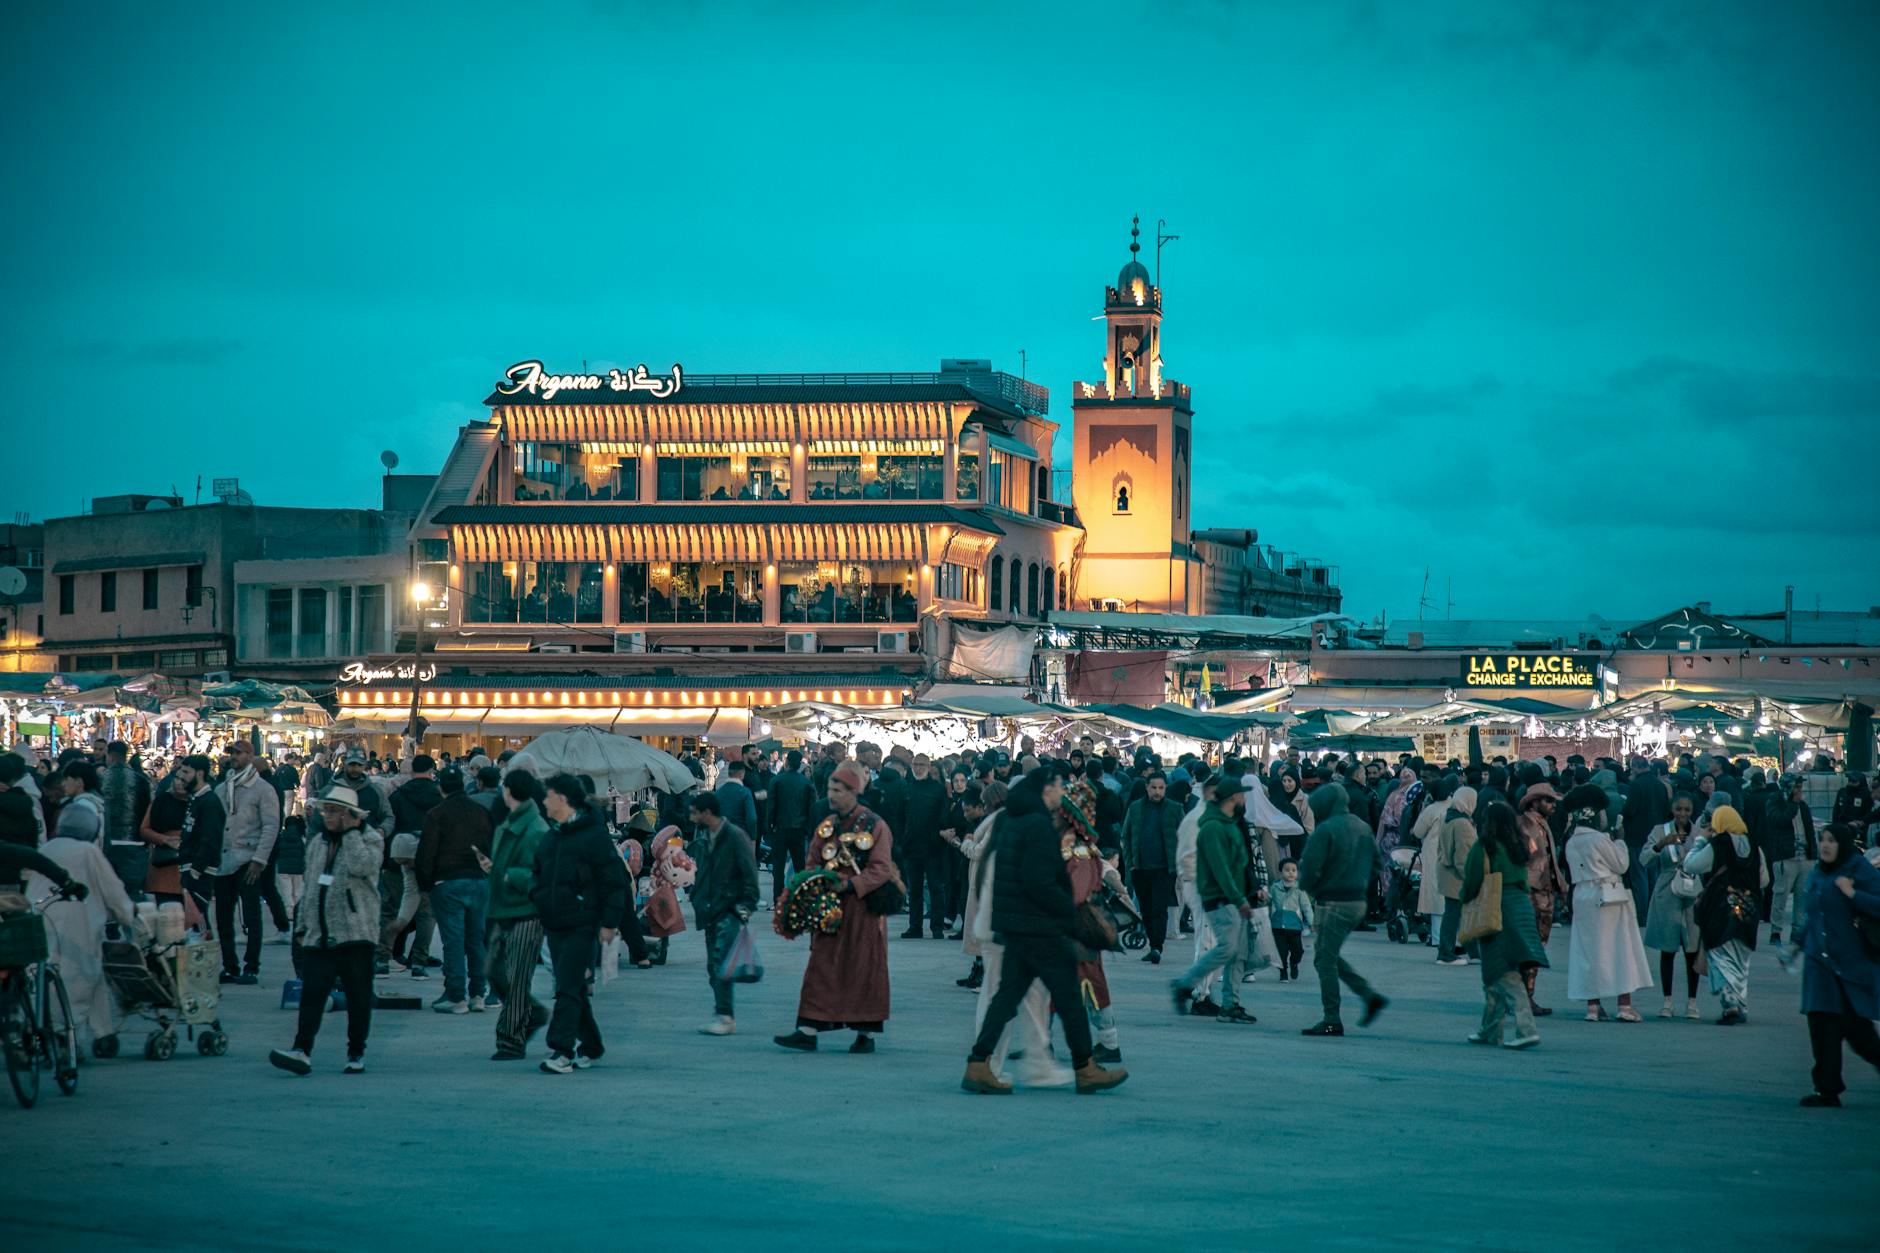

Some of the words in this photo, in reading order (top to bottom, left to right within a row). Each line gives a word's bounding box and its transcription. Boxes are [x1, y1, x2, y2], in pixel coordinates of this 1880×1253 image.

[497, 360, 602, 400] Argana
[339, 663, 395, 684] Argana
[1470, 656, 1496, 673] LA
[1507, 656, 1573, 673] PLACE
[1466, 673, 1516, 685] CHANGE
[1529, 673, 1593, 685] EXCHANGE
